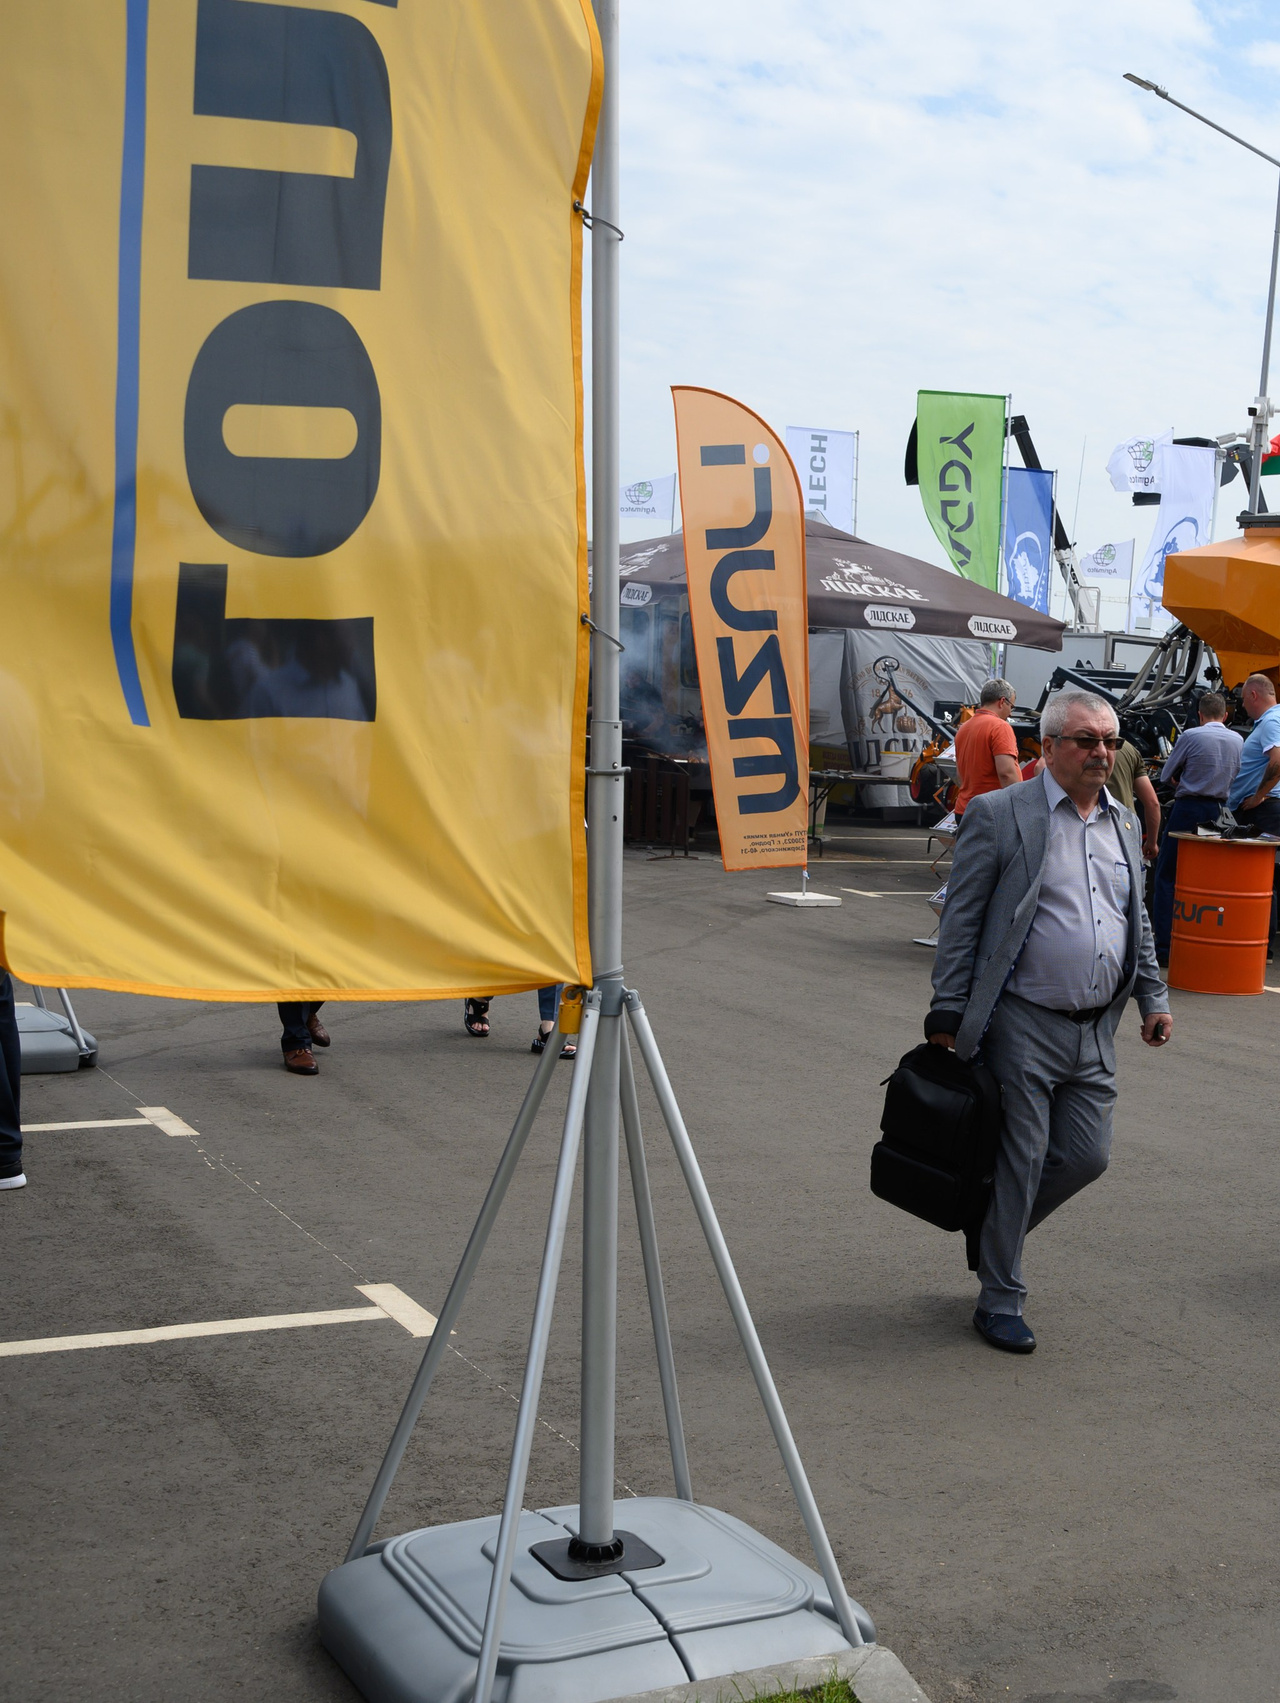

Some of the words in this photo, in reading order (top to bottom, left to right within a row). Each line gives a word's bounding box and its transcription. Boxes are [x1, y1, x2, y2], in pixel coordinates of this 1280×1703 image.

[869, 610, 911, 624] ЛІДСКАЕ
[973, 620, 1013, 635] ЛІДСКАЕ
[1173, 899, 1225, 927] zuri
